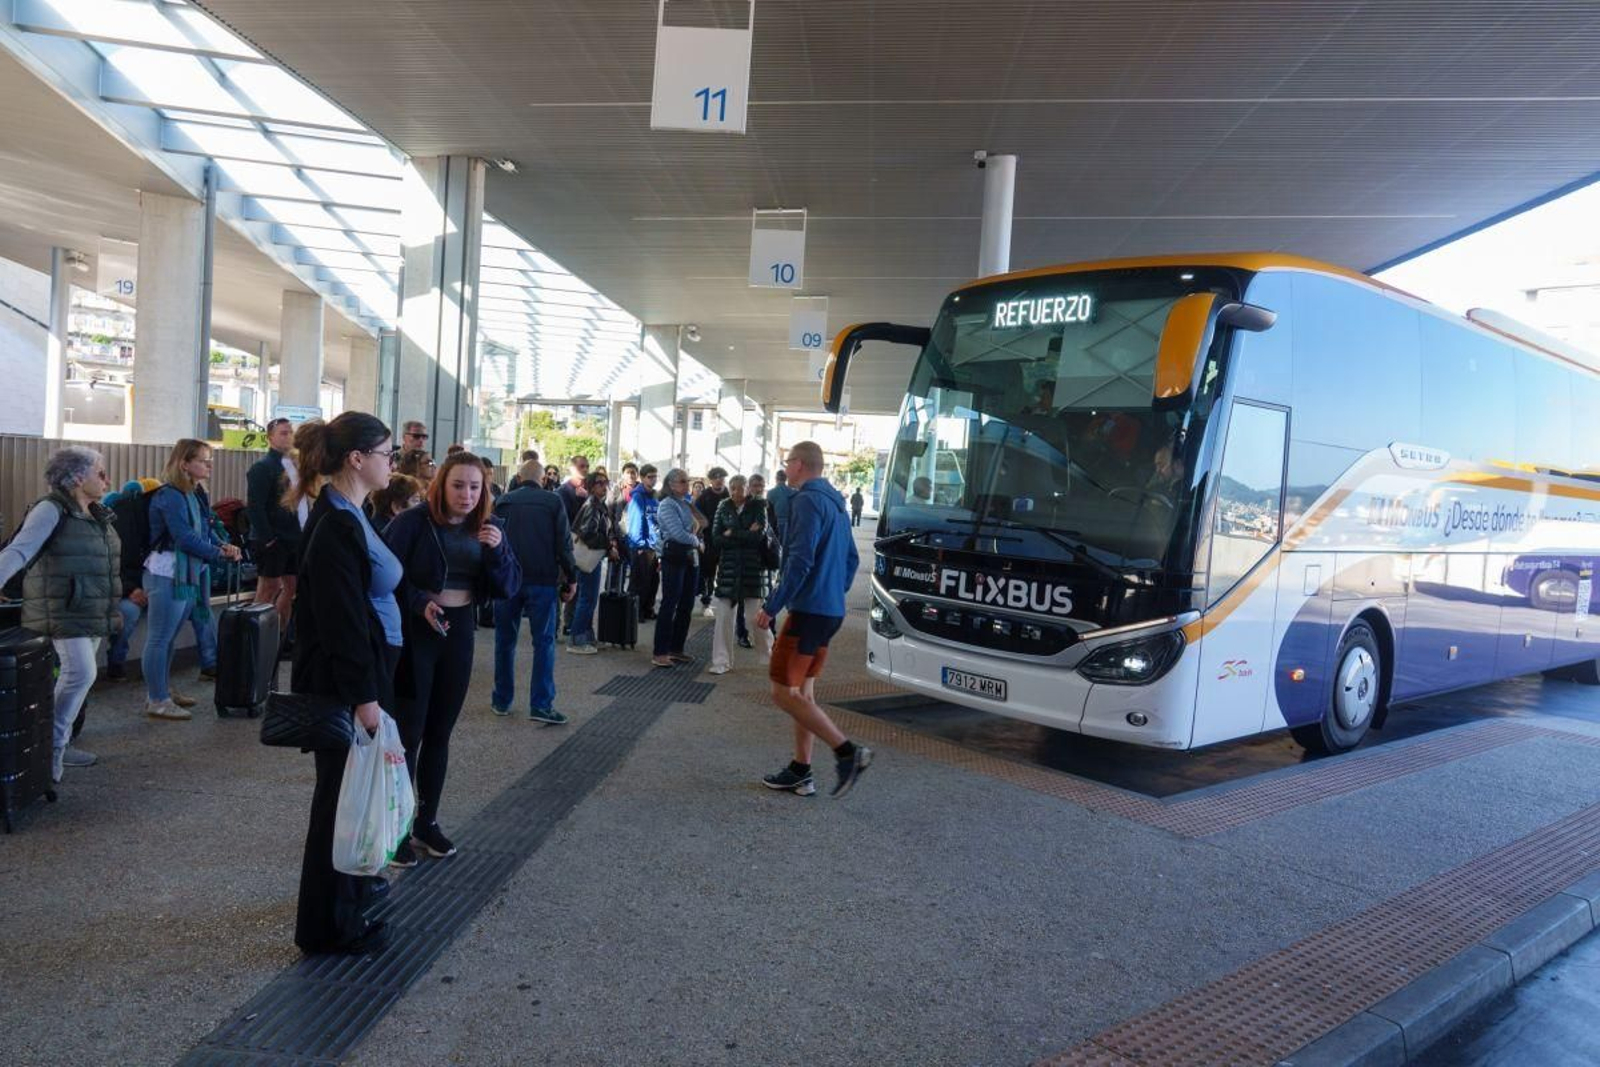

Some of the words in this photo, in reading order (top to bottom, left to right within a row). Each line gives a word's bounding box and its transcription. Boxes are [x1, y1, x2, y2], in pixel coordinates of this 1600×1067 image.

[694, 86, 727, 122] 11
[770, 263, 794, 284] 10
[115, 279, 134, 295] 19
[994, 294, 1091, 327] REFUERZO
[802, 332, 821, 348] 09
[1443, 501, 1489, 537] ¿Desde
[1491, 503, 1525, 532] dónde
[948, 671, 977, 691] 7912
